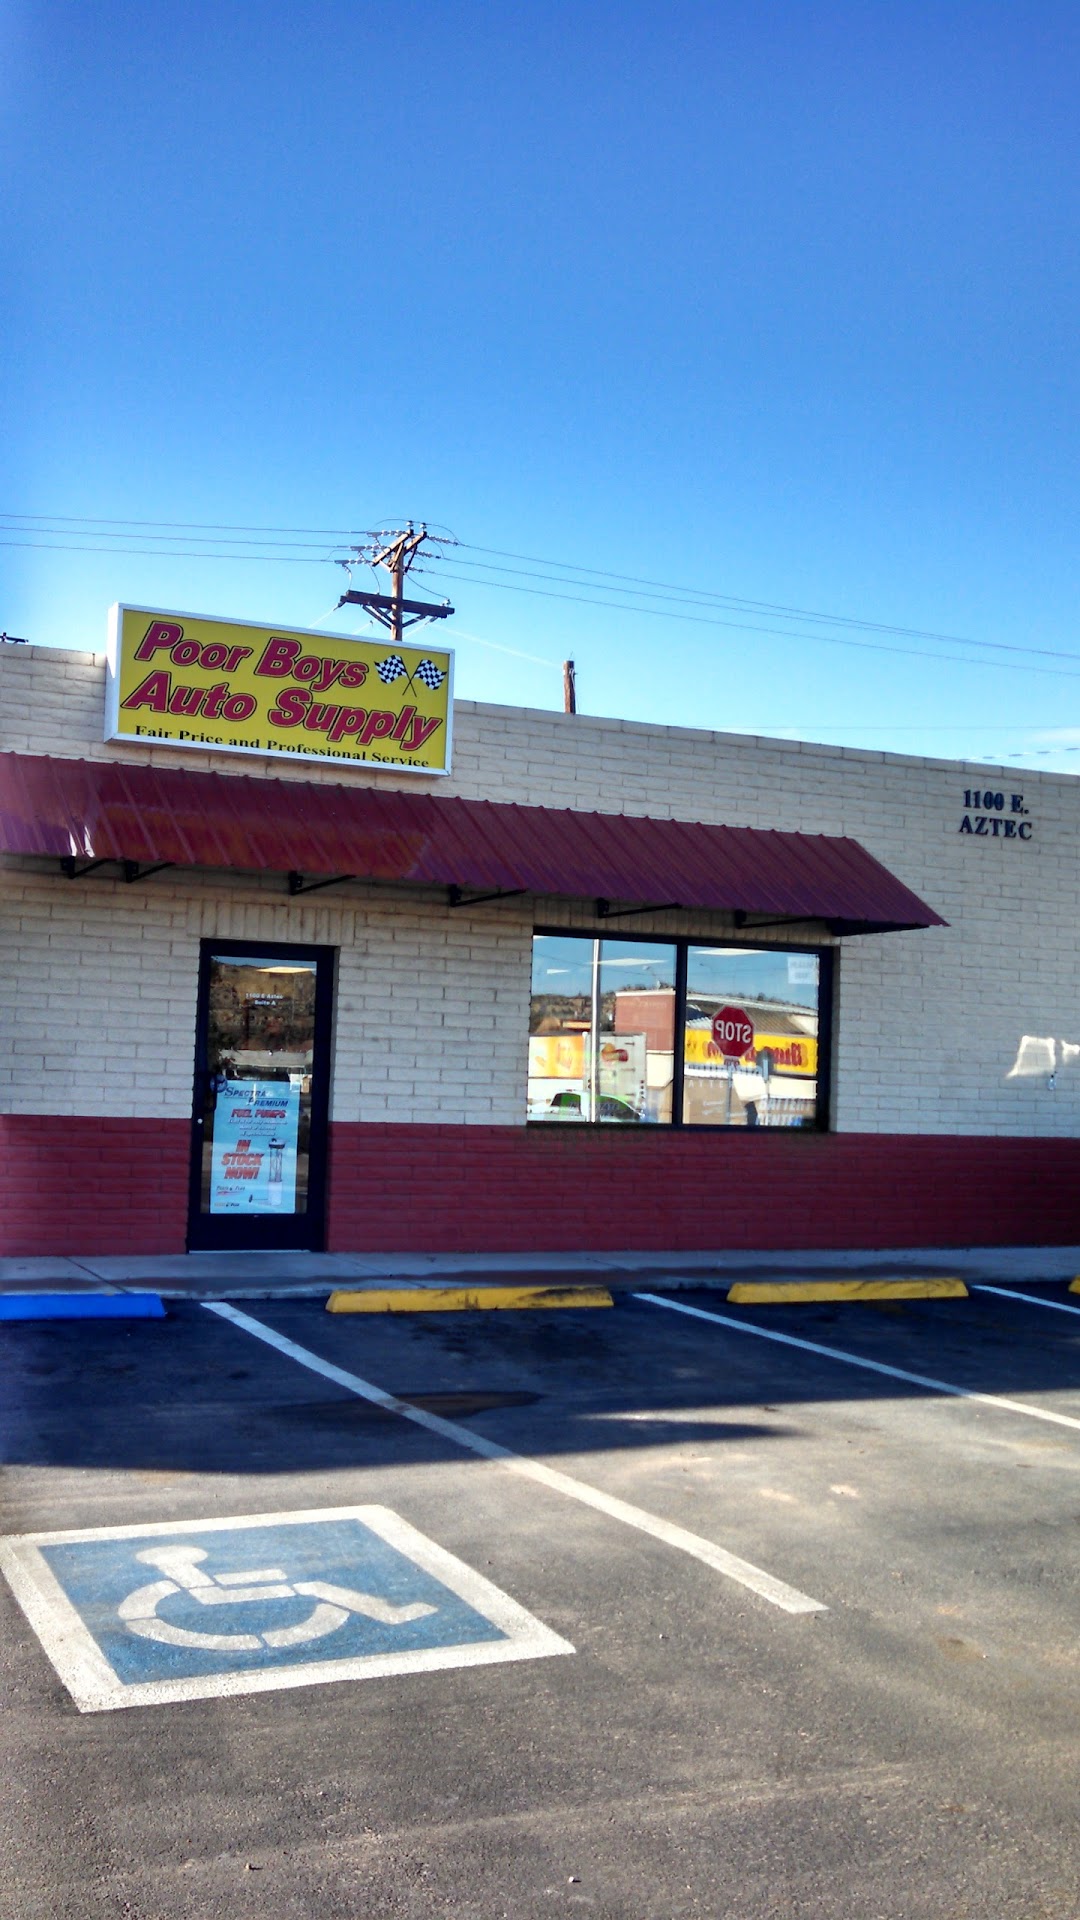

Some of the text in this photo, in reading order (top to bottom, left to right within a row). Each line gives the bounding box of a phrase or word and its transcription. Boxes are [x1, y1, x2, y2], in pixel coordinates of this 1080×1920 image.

[134, 620, 369, 692] Poor Boys
[120, 670, 443, 750] Auto Supply
[135, 725, 429, 768] Fair Price and Professional Service
[963, 789, 1029, 814] 1100 E.
[958, 815, 1032, 840] AZTEC
[224, 1086, 266, 1097] SPECTRA
[247, 1096, 289, 1107] PREMIUM
[231, 1109, 287, 1118] FUEL PUMPS
[235, 1139, 251, 1152] IN
[221, 1152, 264, 1166] STOCK
